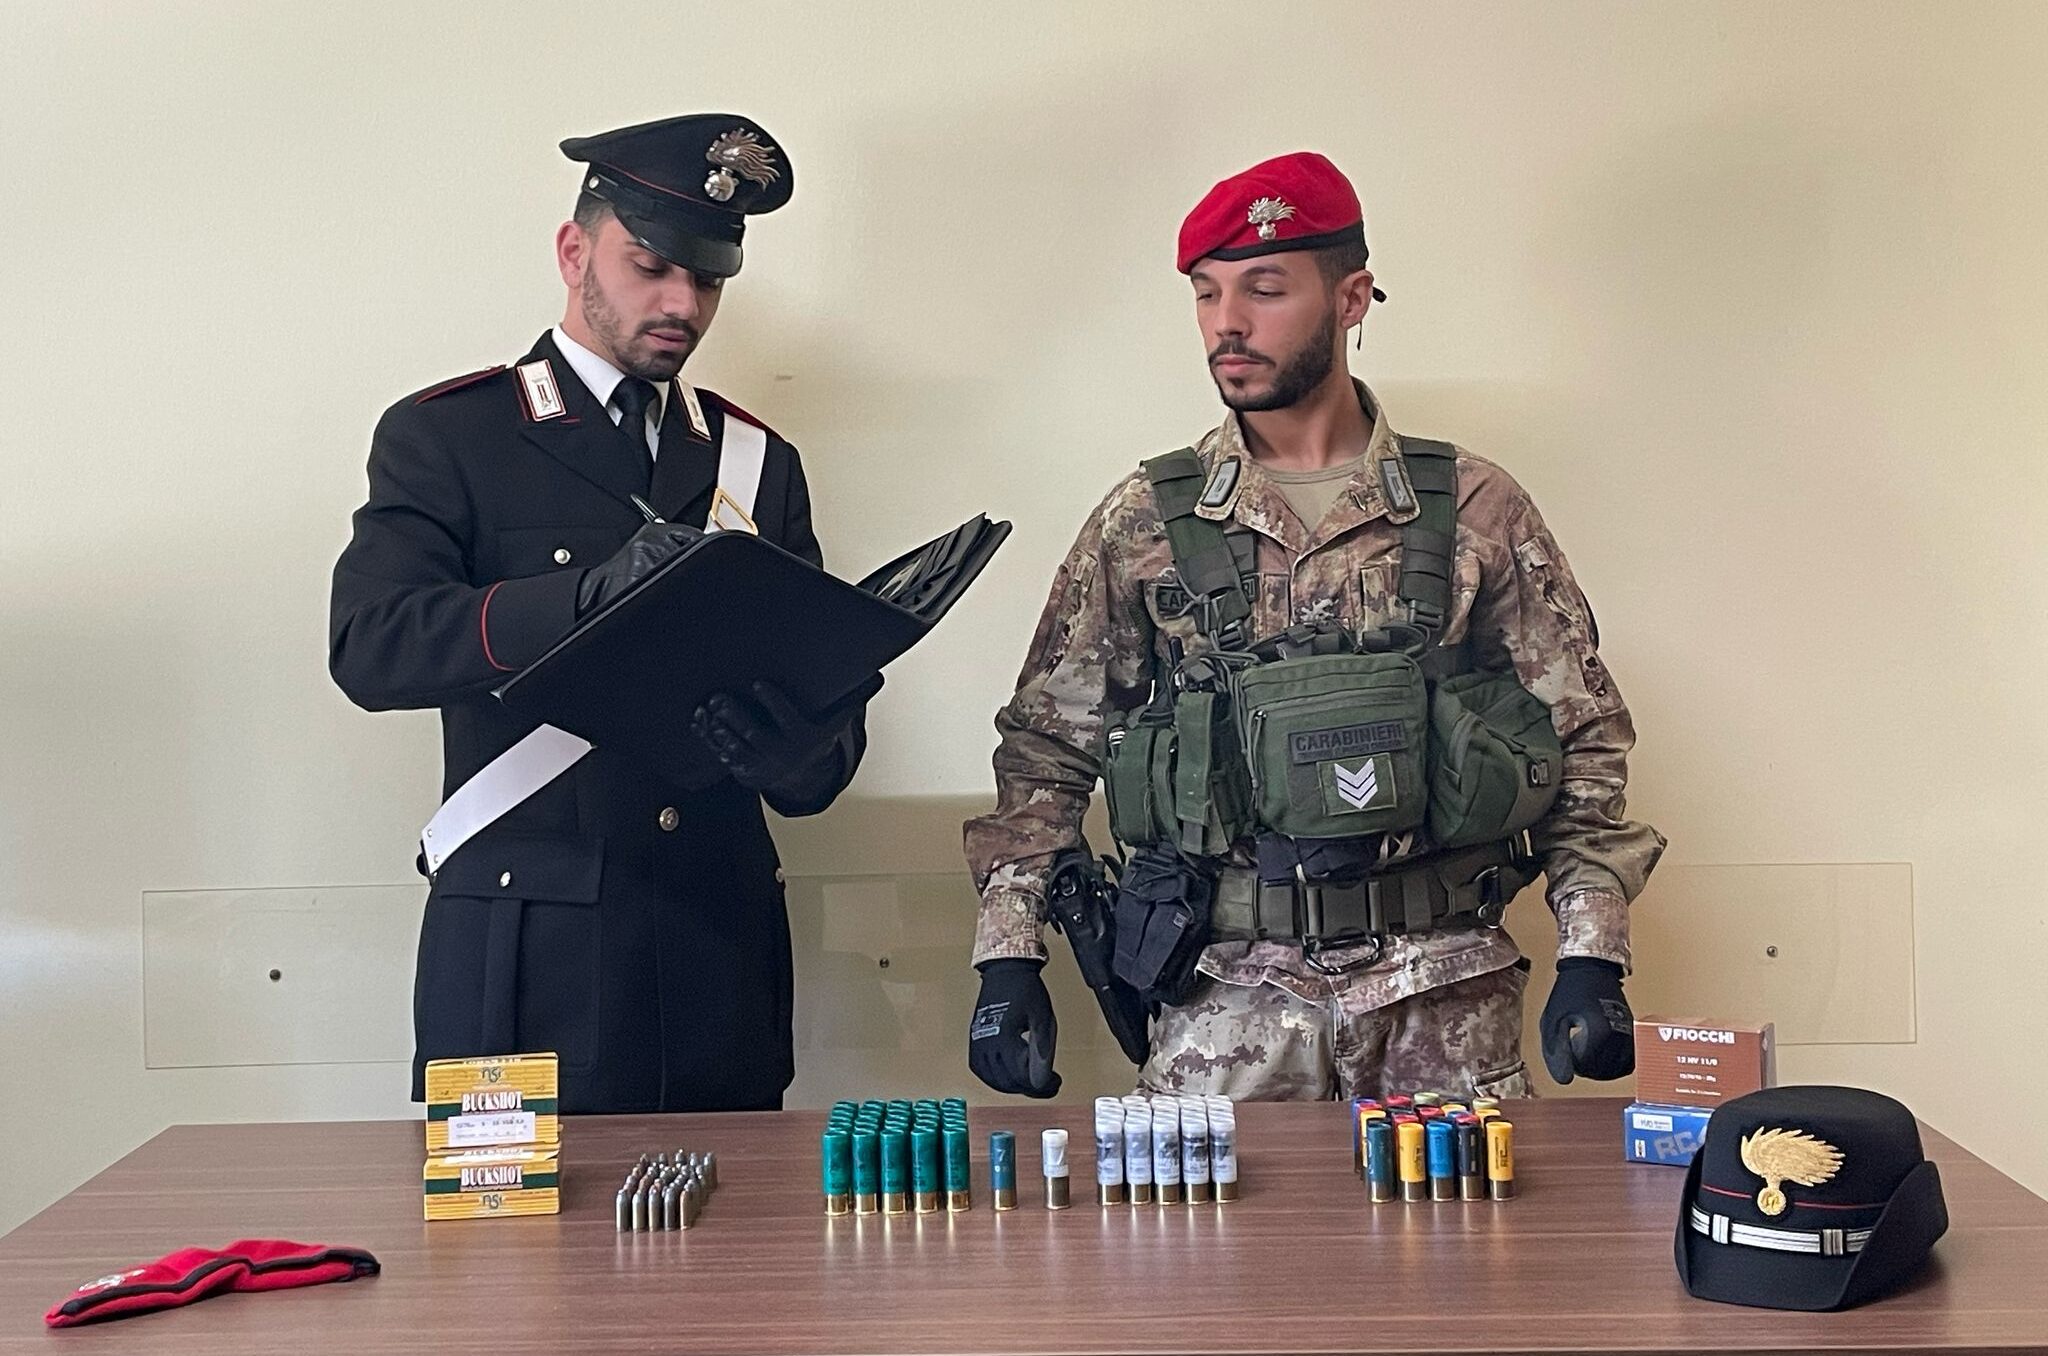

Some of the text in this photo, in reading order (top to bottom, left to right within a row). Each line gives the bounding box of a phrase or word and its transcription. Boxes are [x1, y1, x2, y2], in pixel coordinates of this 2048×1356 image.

[1295, 723, 1402, 751] CARABINIERI
[1672, 1027, 1735, 1044] FIOCCHI
[462, 1091, 522, 1112] BUCKSHOT
[461, 1165, 523, 1186] BUCKSHOT
